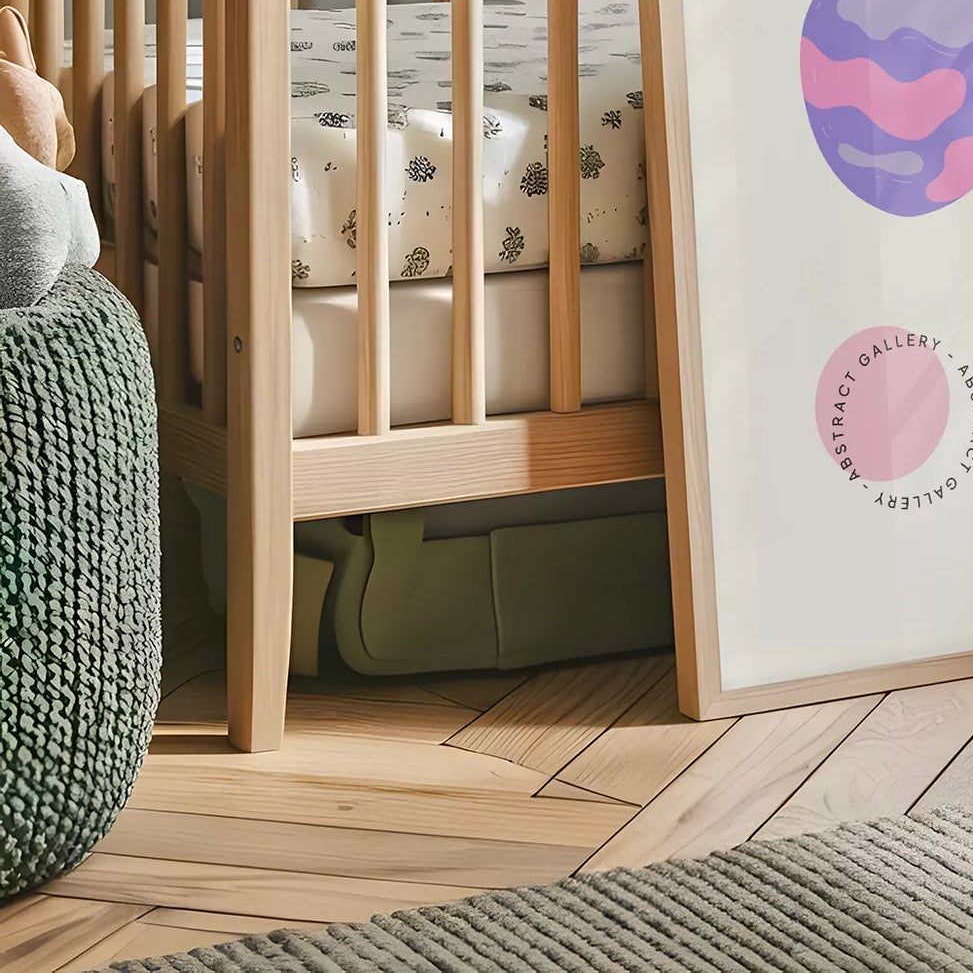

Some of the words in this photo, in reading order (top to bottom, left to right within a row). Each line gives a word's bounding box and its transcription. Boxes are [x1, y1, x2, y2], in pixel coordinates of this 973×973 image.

[858, 333, 941, 366] GALLERY
[832, 371, 860, 481] ABSTRACT
[874, 477, 957, 510] GALLERY
